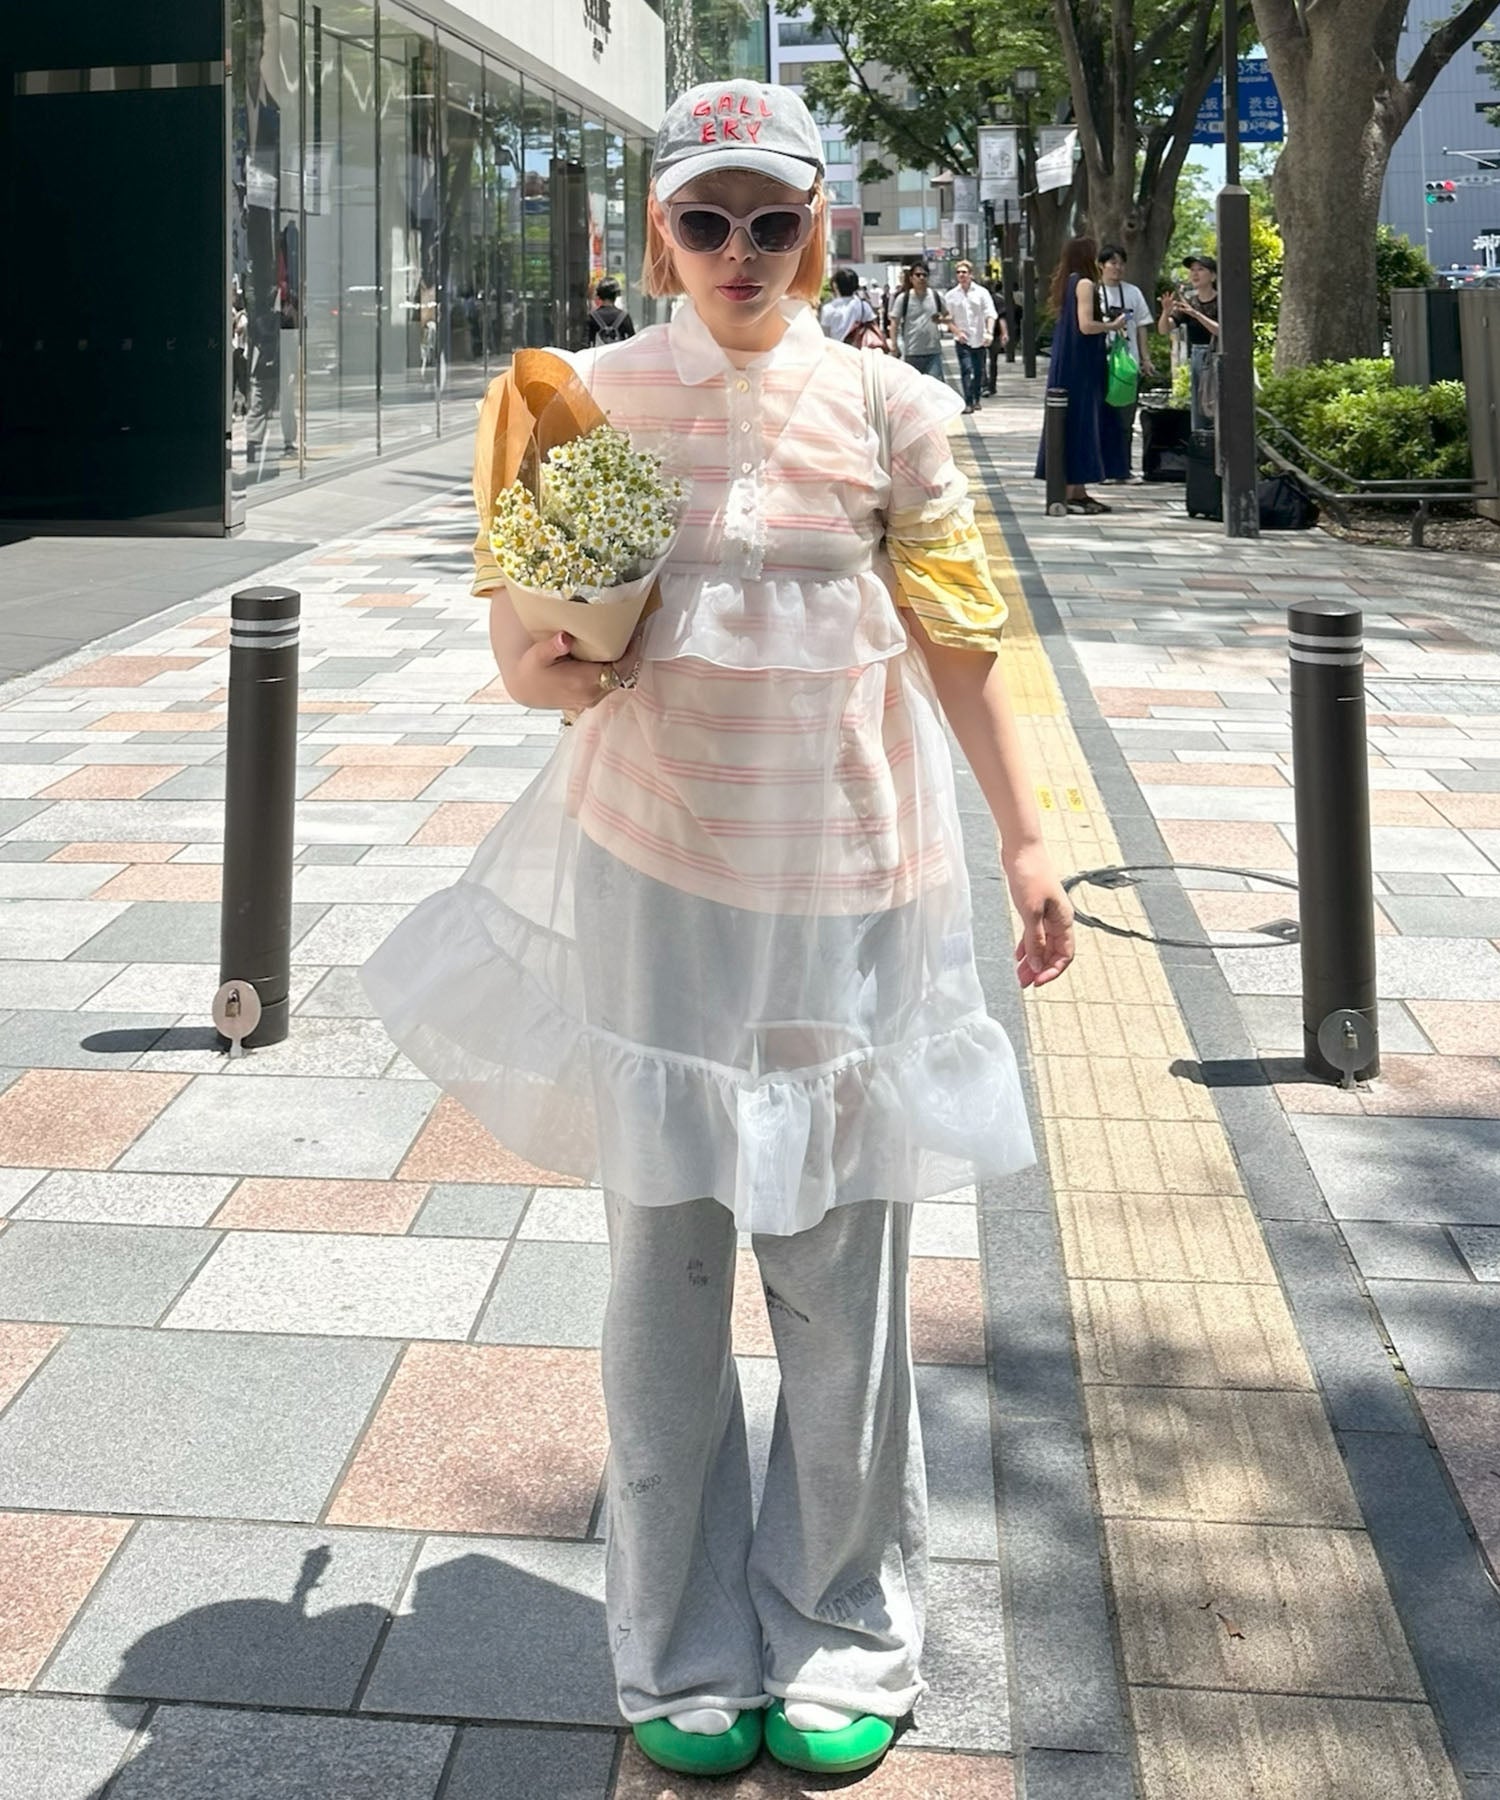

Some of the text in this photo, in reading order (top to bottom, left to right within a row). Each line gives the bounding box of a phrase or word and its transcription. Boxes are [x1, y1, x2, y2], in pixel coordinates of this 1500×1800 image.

[692, 93, 773, 117] GALL
[1248, 96, 1279, 109] 渋谷
[1249, 110, 1279, 118] Shibuya
